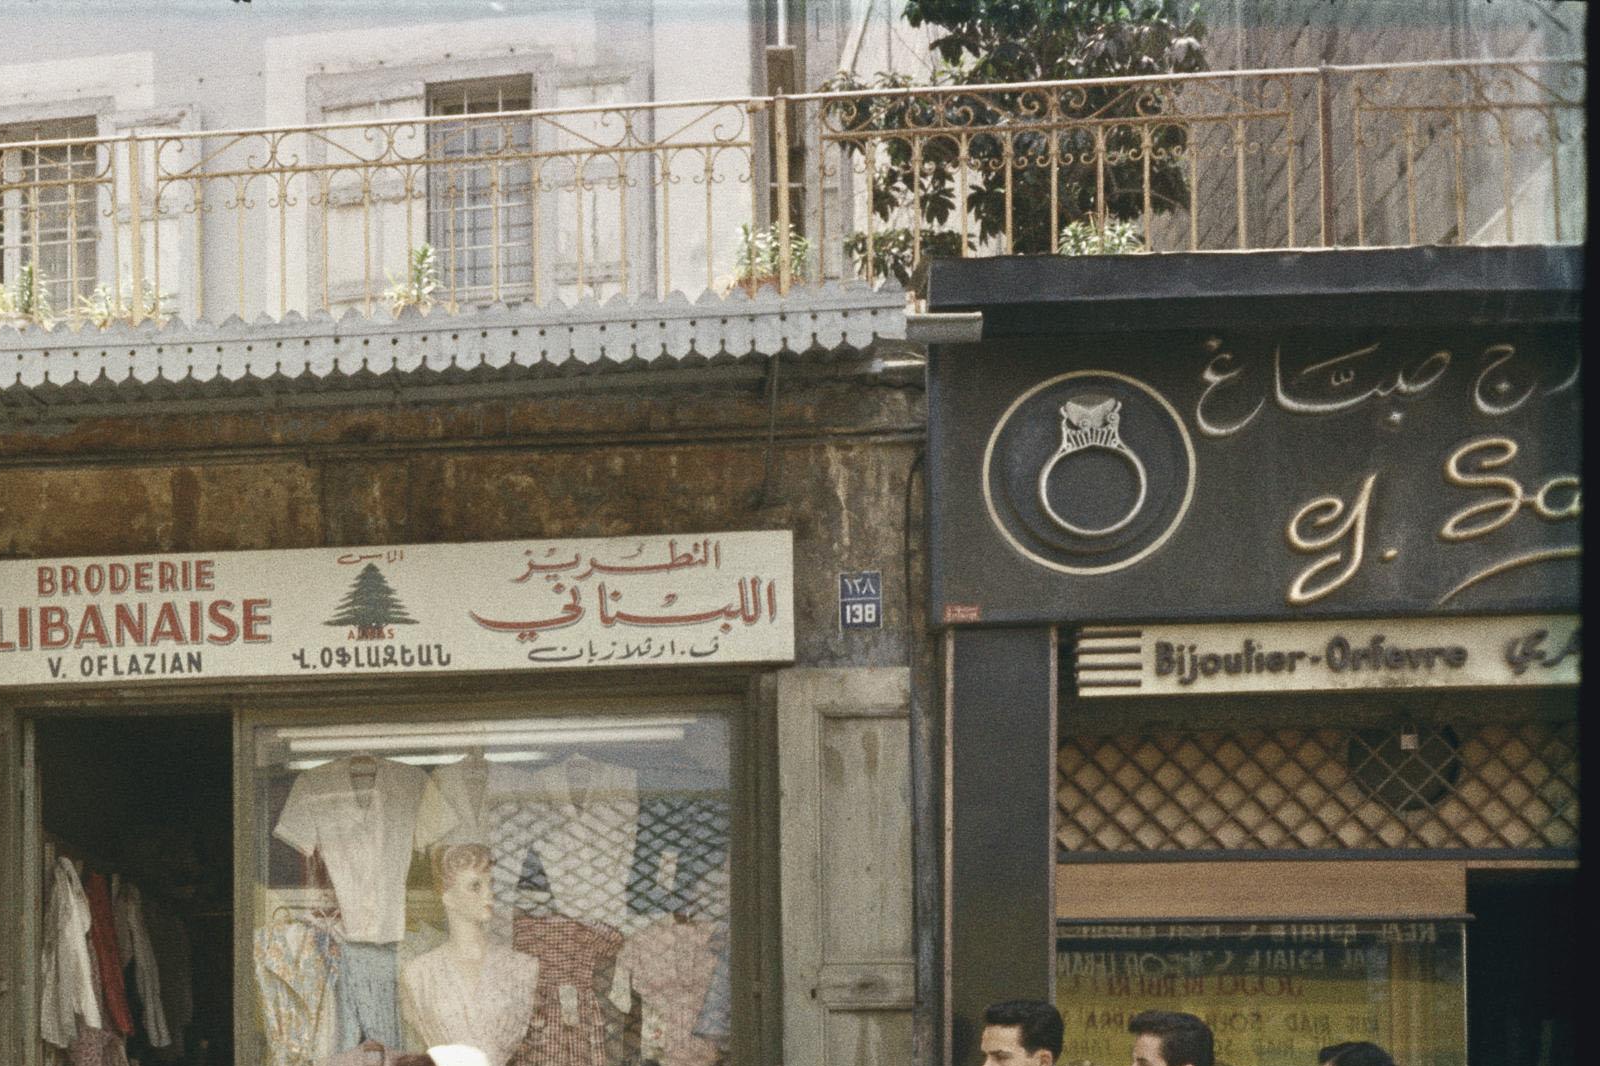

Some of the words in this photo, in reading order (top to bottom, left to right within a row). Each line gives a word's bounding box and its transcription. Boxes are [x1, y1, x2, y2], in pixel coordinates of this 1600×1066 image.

[37, 560, 215, 597] BRODERIE
[846, 603, 876, 623] 138
[48, 656, 67, 679] V.
[80, 651, 203, 677] OFLAZIAN
